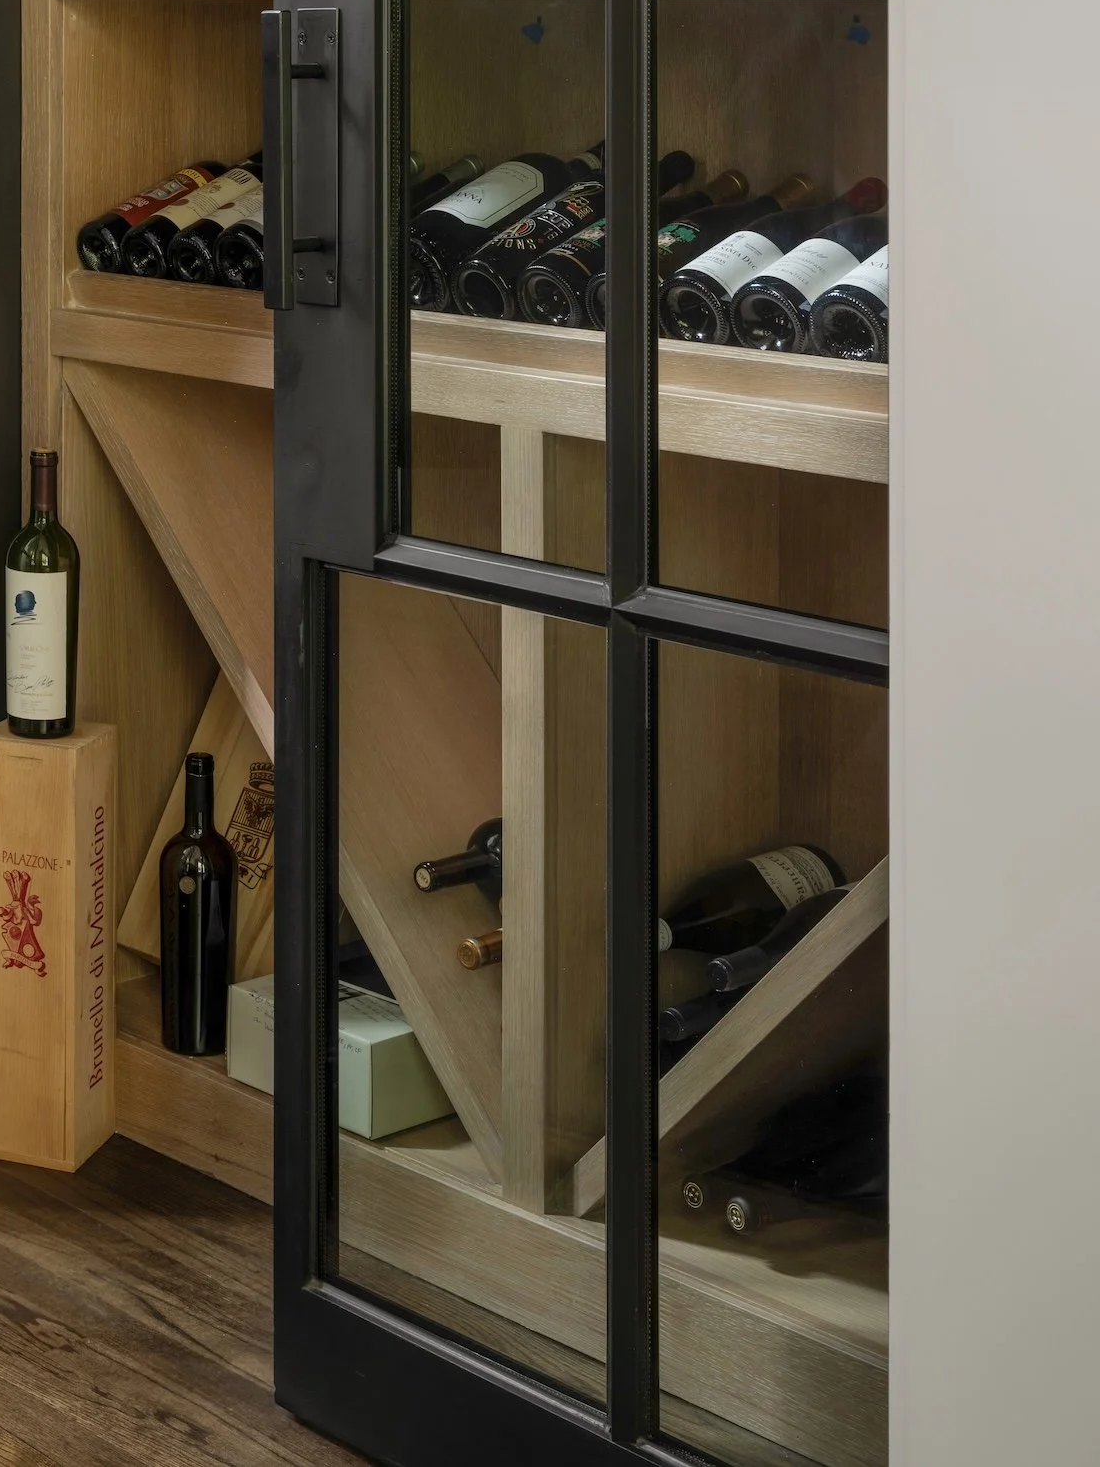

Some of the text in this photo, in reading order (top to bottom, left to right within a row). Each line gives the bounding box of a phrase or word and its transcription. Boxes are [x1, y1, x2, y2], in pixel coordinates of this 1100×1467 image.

[2, 850, 58, 871] PALAZZONE
[89, 805, 105, 1091] Brunello di Montalcino
